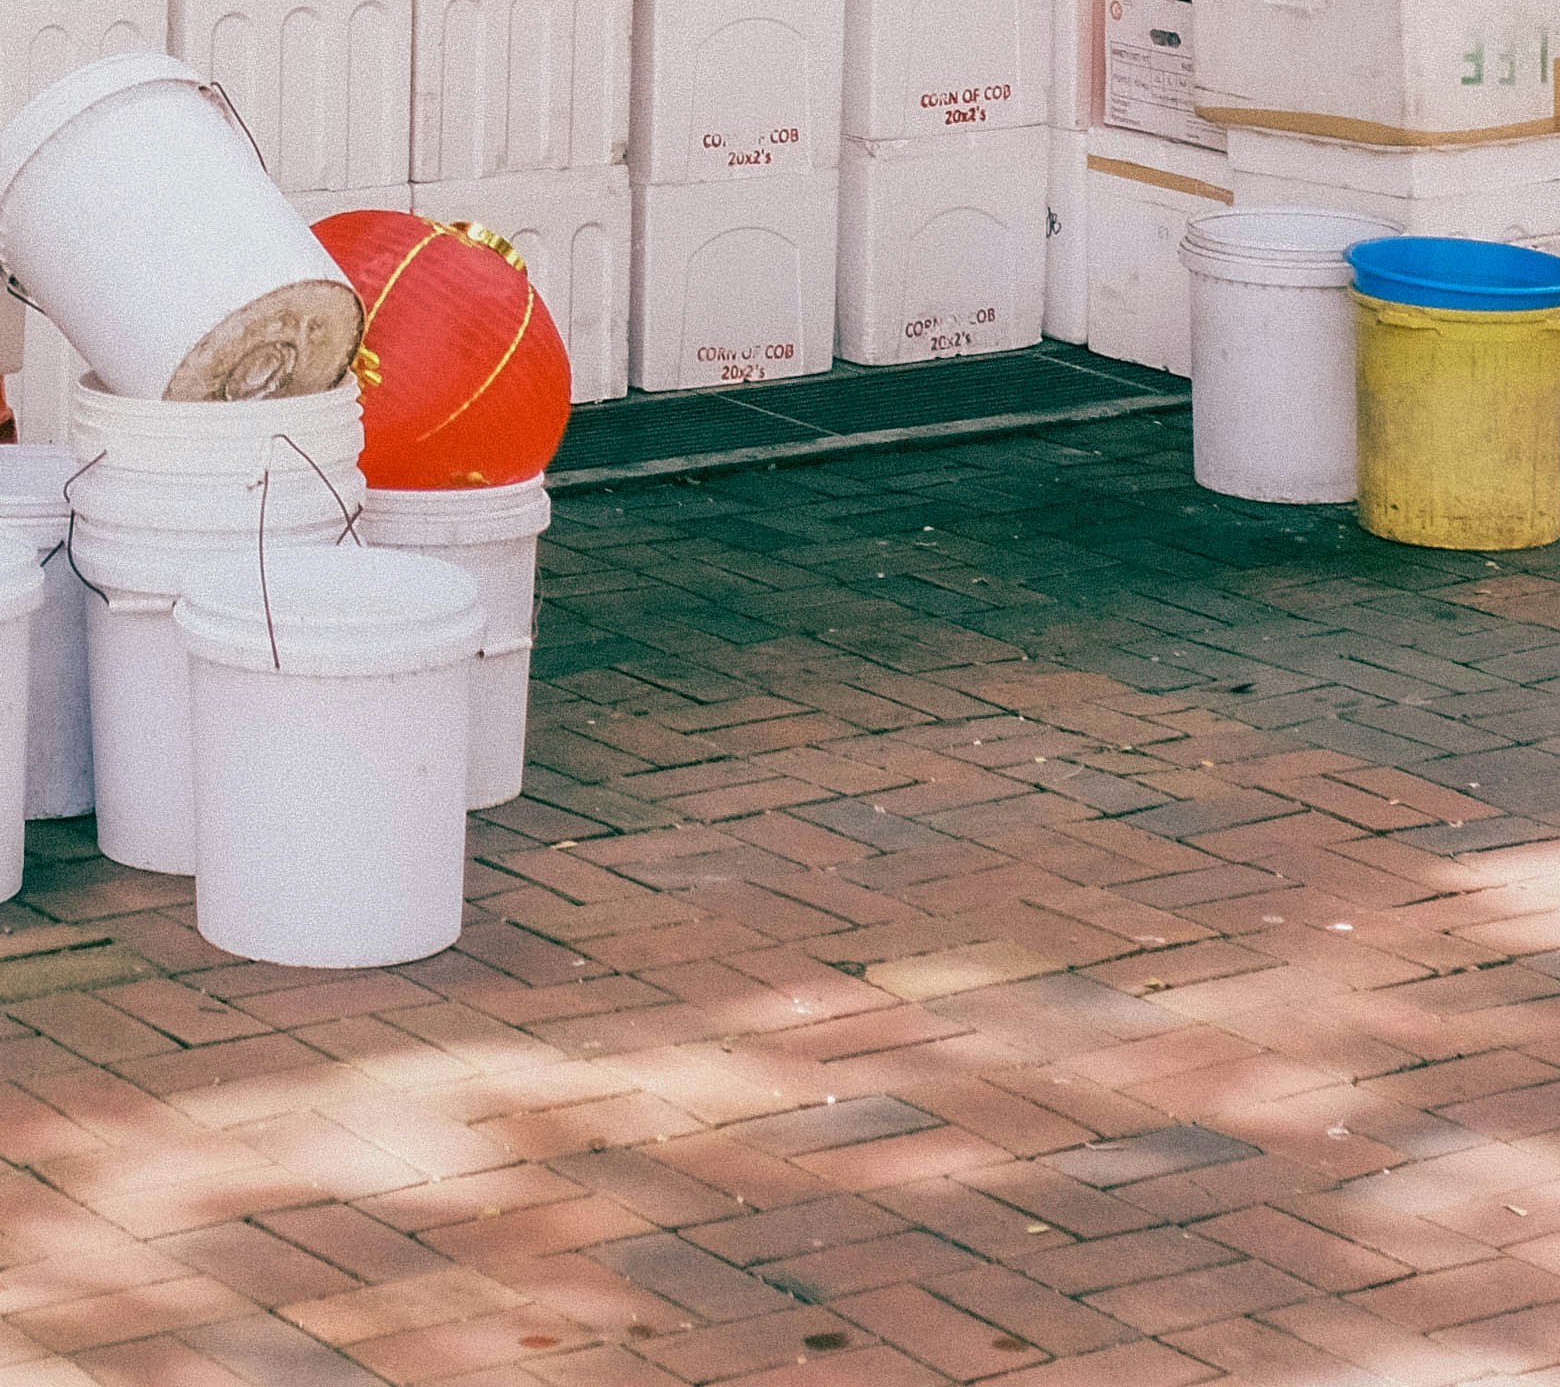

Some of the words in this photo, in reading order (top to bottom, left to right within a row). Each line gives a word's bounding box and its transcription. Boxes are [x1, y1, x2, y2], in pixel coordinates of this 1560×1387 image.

[920, 90, 959, 108] CORN
[962, 88, 980, 104] OF
[984, 84, 1012, 101] COB
[769, 127, 800, 144] COB
[968, 307, 996, 325] OB
[764, 343, 795, 359] COB
